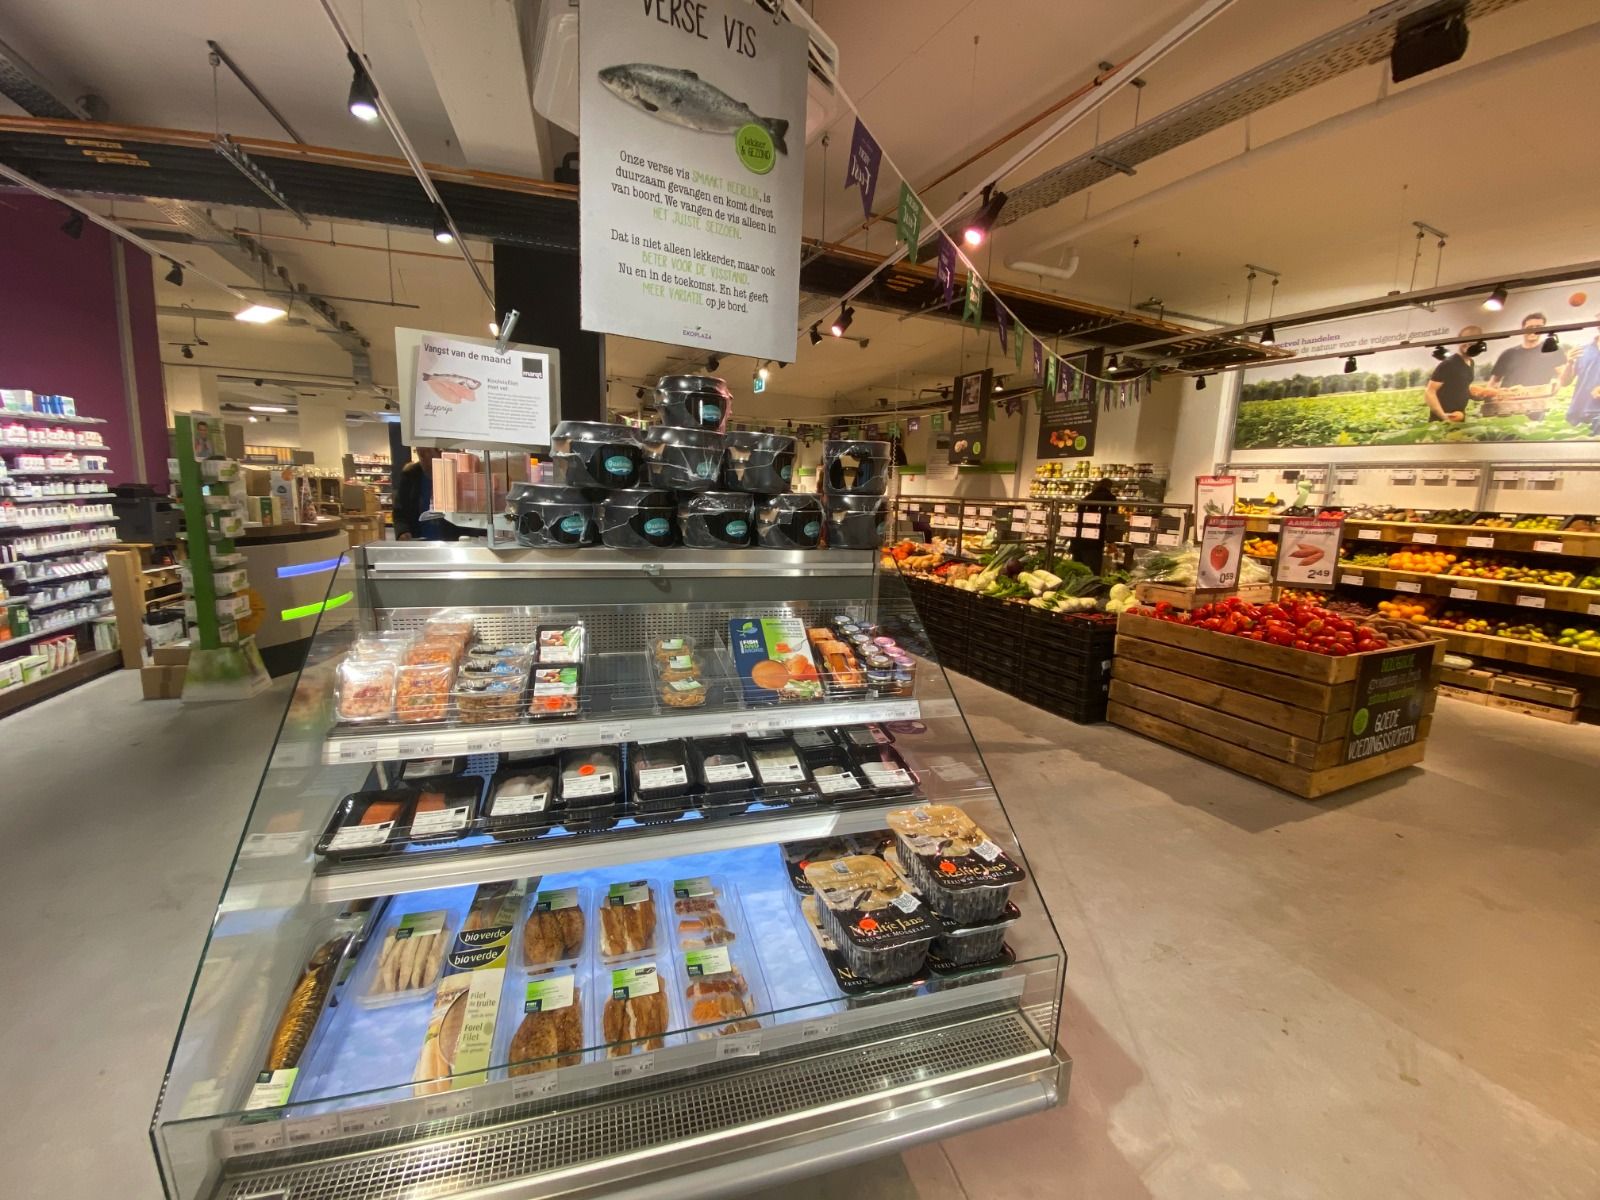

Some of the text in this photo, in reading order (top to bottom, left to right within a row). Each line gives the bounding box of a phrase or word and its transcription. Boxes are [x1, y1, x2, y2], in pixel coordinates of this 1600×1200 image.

[643, 0, 757, 58] VERSE VIS
[615, 166, 773, 219] duurzaam gevangen en komt direct
[620, 151, 645, 167] Onze
[647, 159, 673, 175] verse
[676, 167, 690, 180] vis
[763, 193, 771, 203] is
[611, 182, 776, 234] van boord. We vangen de vis alleen in
[611, 229, 776, 276] Dat is niet alleen lekkerder, maar ook
[618, 262, 768, 303] Nu en in de toekomst. En het geeft
[706, 296, 717, 310] op
[719, 298, 726, 310] je
[728, 299, 748, 313] bord.
[1301, 333, 1341, 346] handelen
[1408, 326, 1450, 341] generatie
[424, 343, 511, 365] Vangst van de maand
[1307, 569, 1330, 579] 249
[895, 916, 925, 931] Jans
